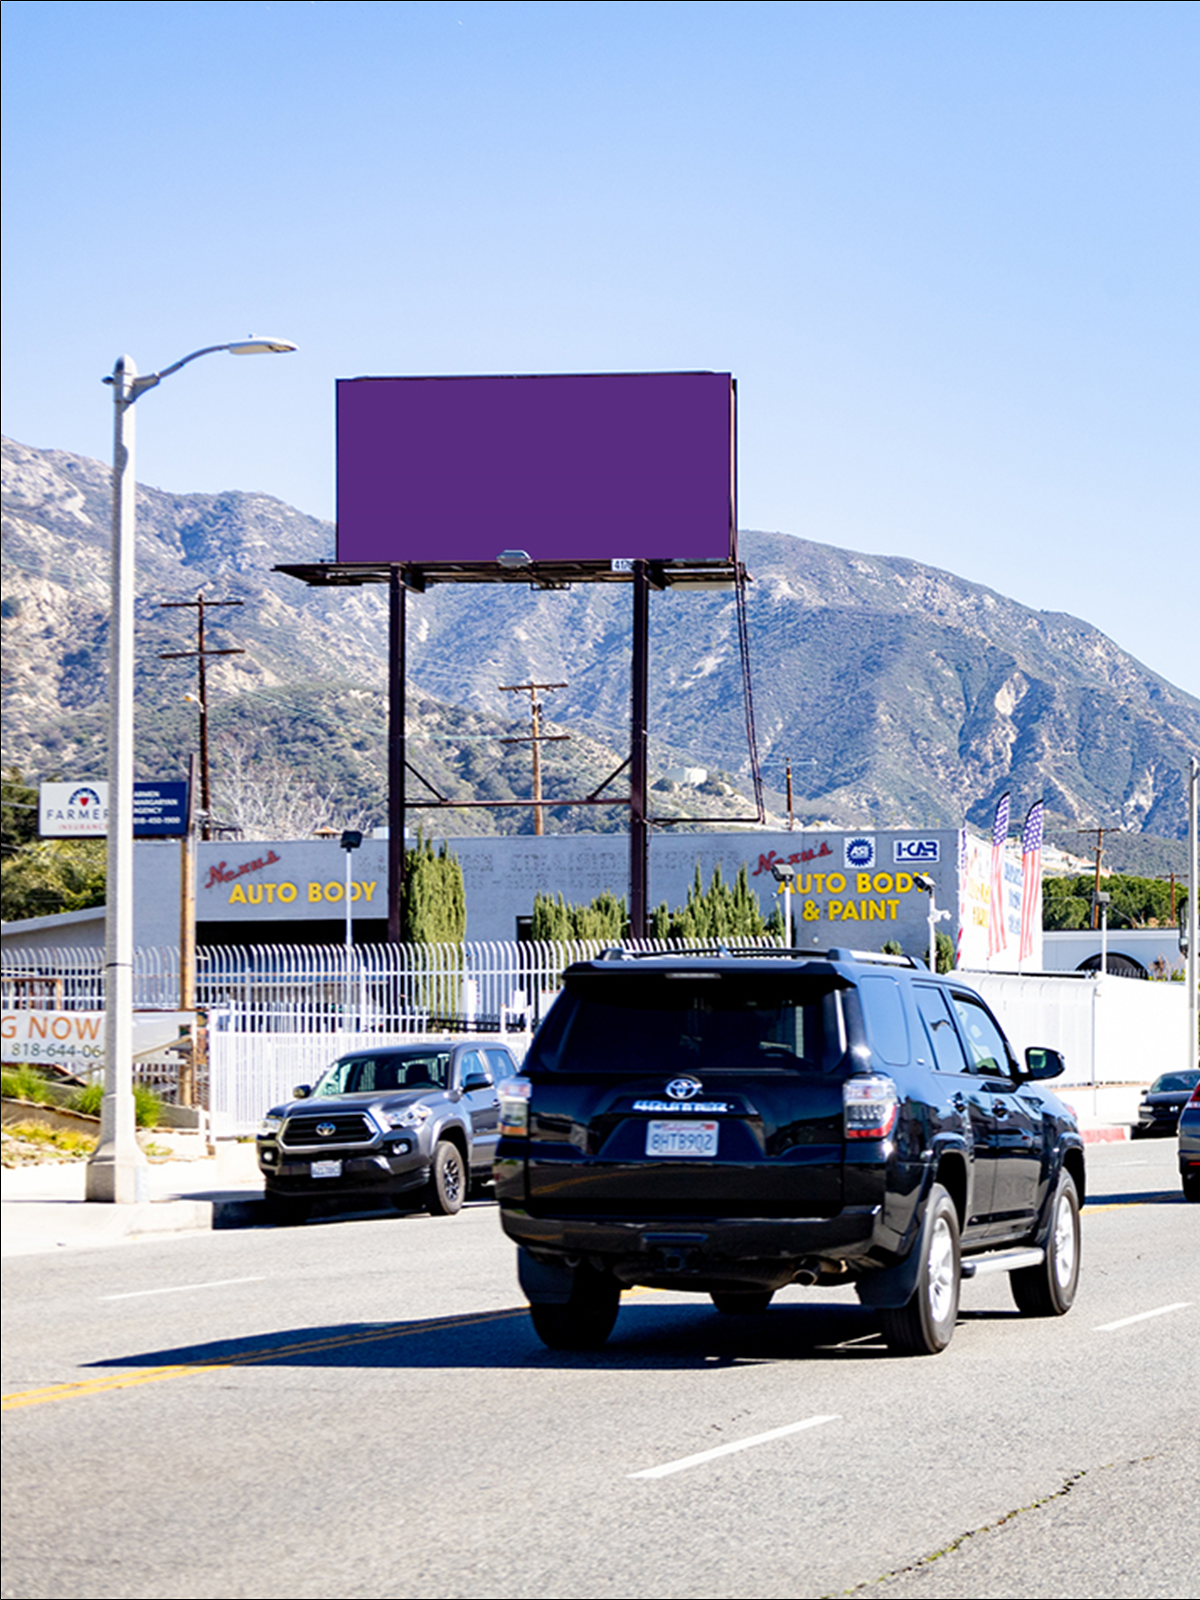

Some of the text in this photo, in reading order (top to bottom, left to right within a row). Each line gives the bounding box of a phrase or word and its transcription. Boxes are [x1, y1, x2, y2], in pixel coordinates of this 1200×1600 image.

[46, 808, 108, 820] FARMER
[229, 881, 377, 904] AUTO BODY
[777, 872, 929, 894] AUTO BODY
[802, 899, 900, 921] & PAINT
[28, 1016, 102, 1040] NOW
[11, 1043, 105, 1058] 818-644-06
[651, 1134, 713, 1151] 8HTB902
